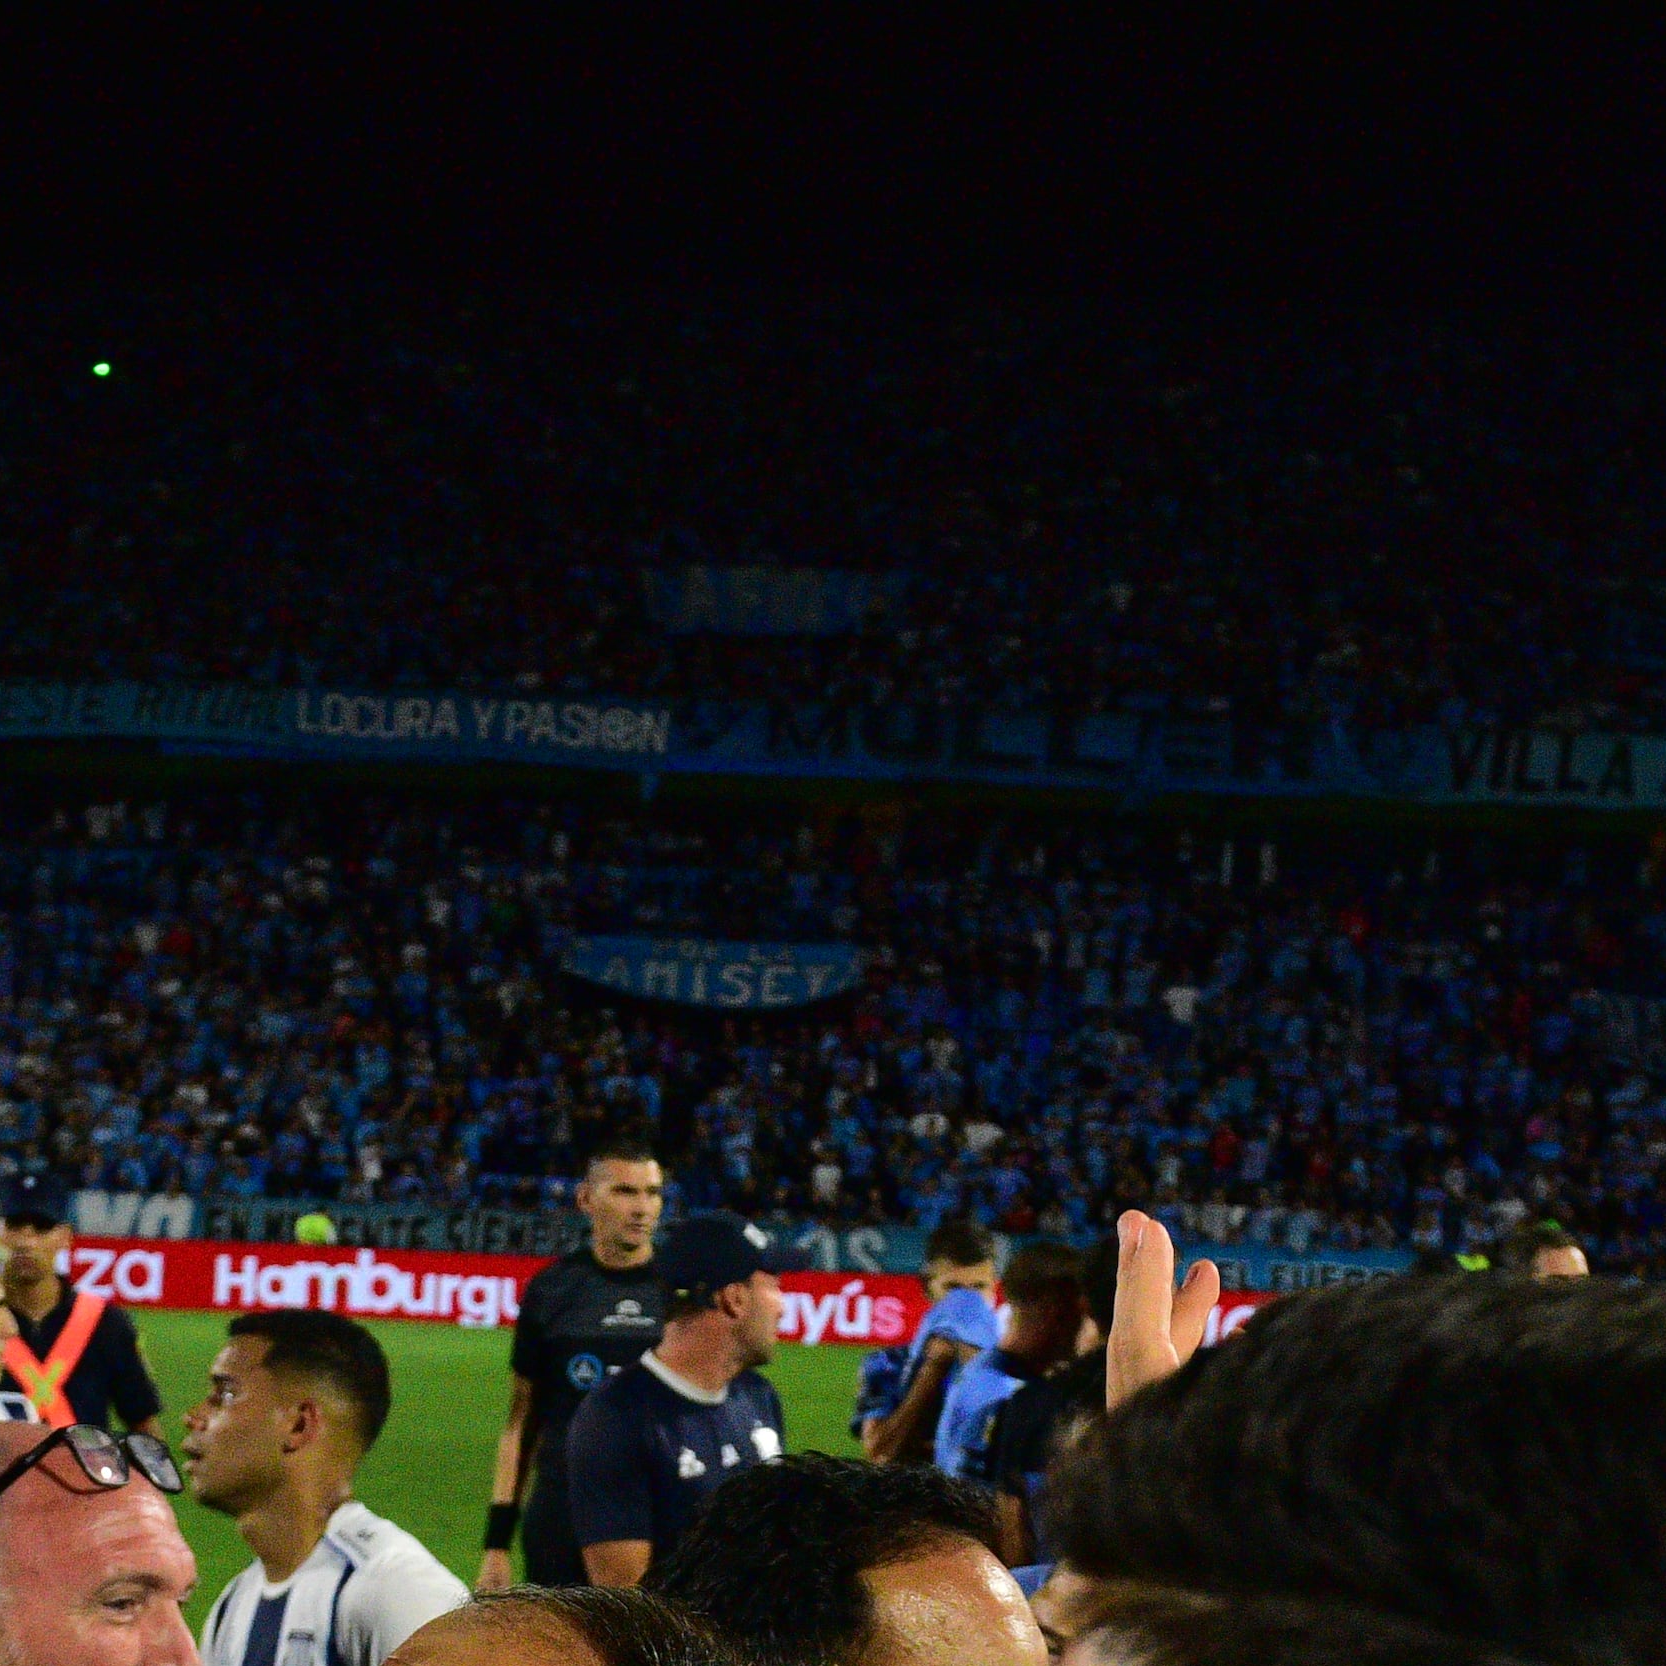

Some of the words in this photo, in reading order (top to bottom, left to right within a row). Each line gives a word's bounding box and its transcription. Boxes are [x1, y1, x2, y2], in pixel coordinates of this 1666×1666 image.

[296, 690, 459, 742] LOCURA
[470, 697, 500, 742] Y
[1445, 726, 1633, 796] VILLA
